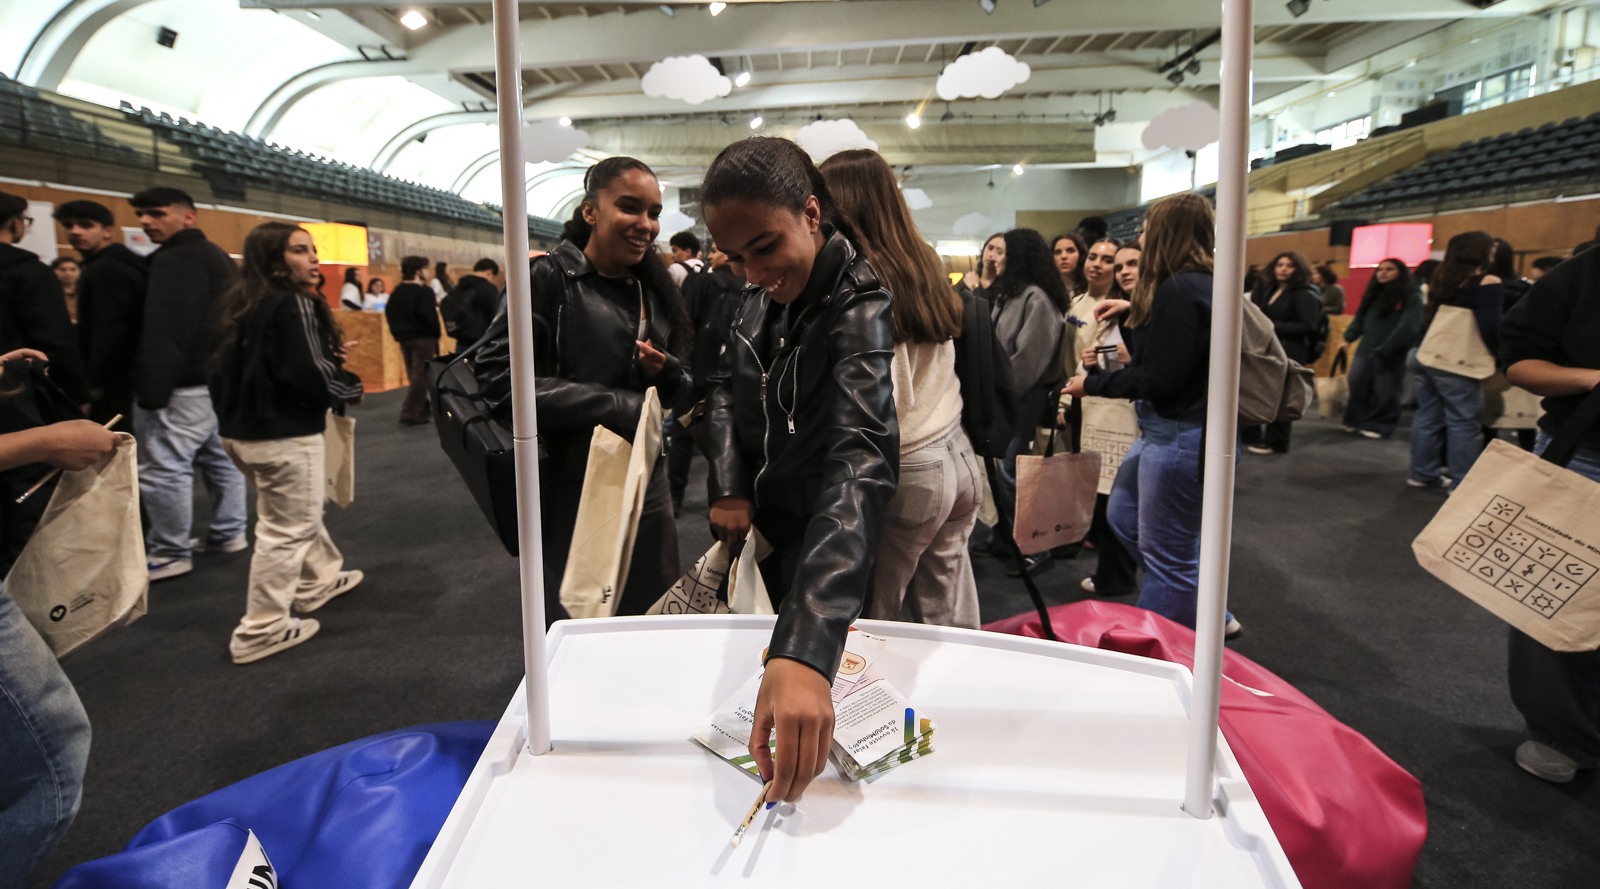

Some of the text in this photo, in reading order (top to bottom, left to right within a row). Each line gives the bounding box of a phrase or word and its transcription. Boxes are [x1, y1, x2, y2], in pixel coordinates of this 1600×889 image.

[1525, 515, 1573, 540] Universidade
[1586, 545, 1600, 555] Min
[733, 710, 748, 722] falar
[852, 743, 869, 754] falar
